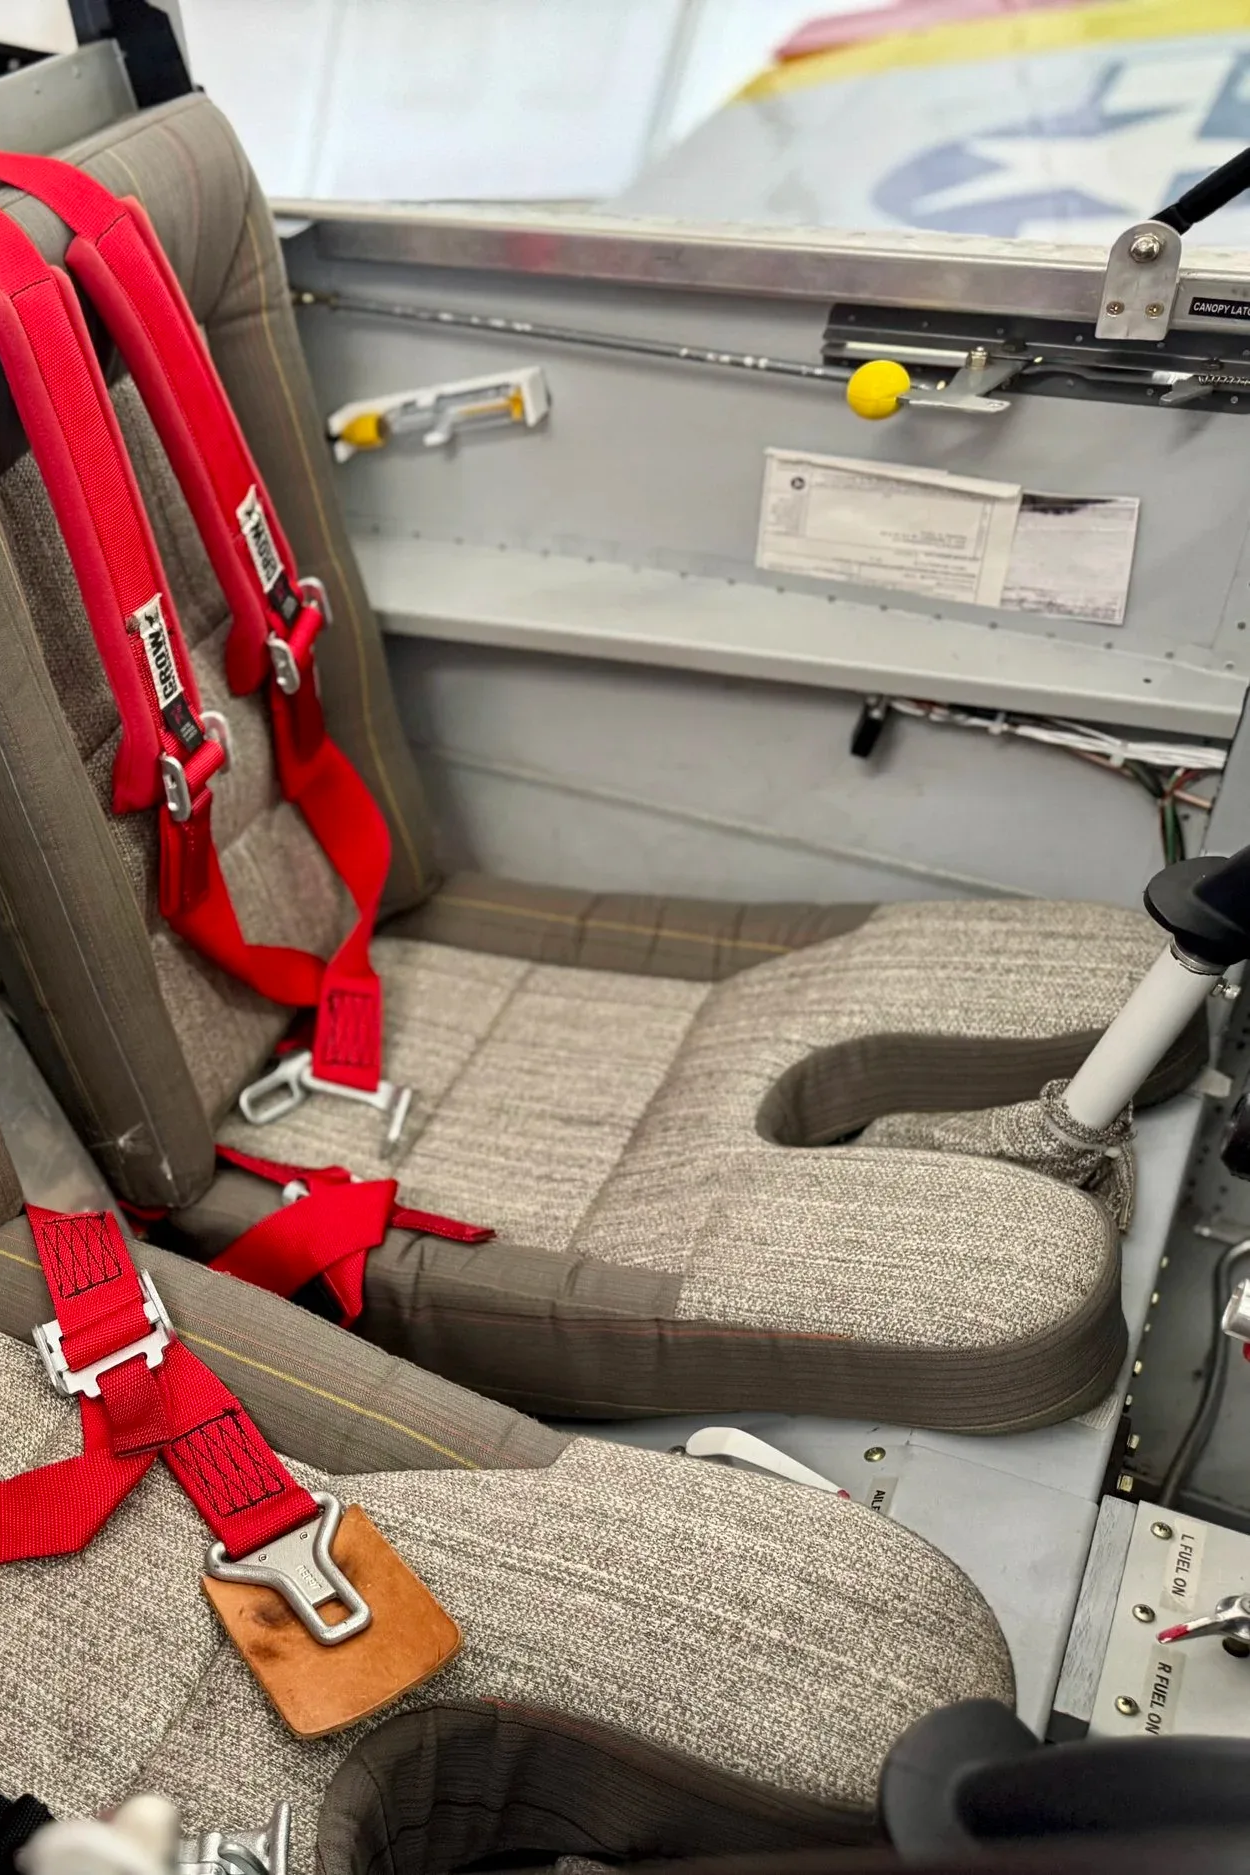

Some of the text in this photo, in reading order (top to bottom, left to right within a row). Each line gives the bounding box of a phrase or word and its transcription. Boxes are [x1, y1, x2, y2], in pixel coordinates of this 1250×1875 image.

[1193, 302, 1230, 314] CANOPY
[149, 631, 174, 700] CROW
[1171, 1533, 1194, 1597] L FUEL ON
[1144, 1661, 1172, 1735] R FUEL ON
